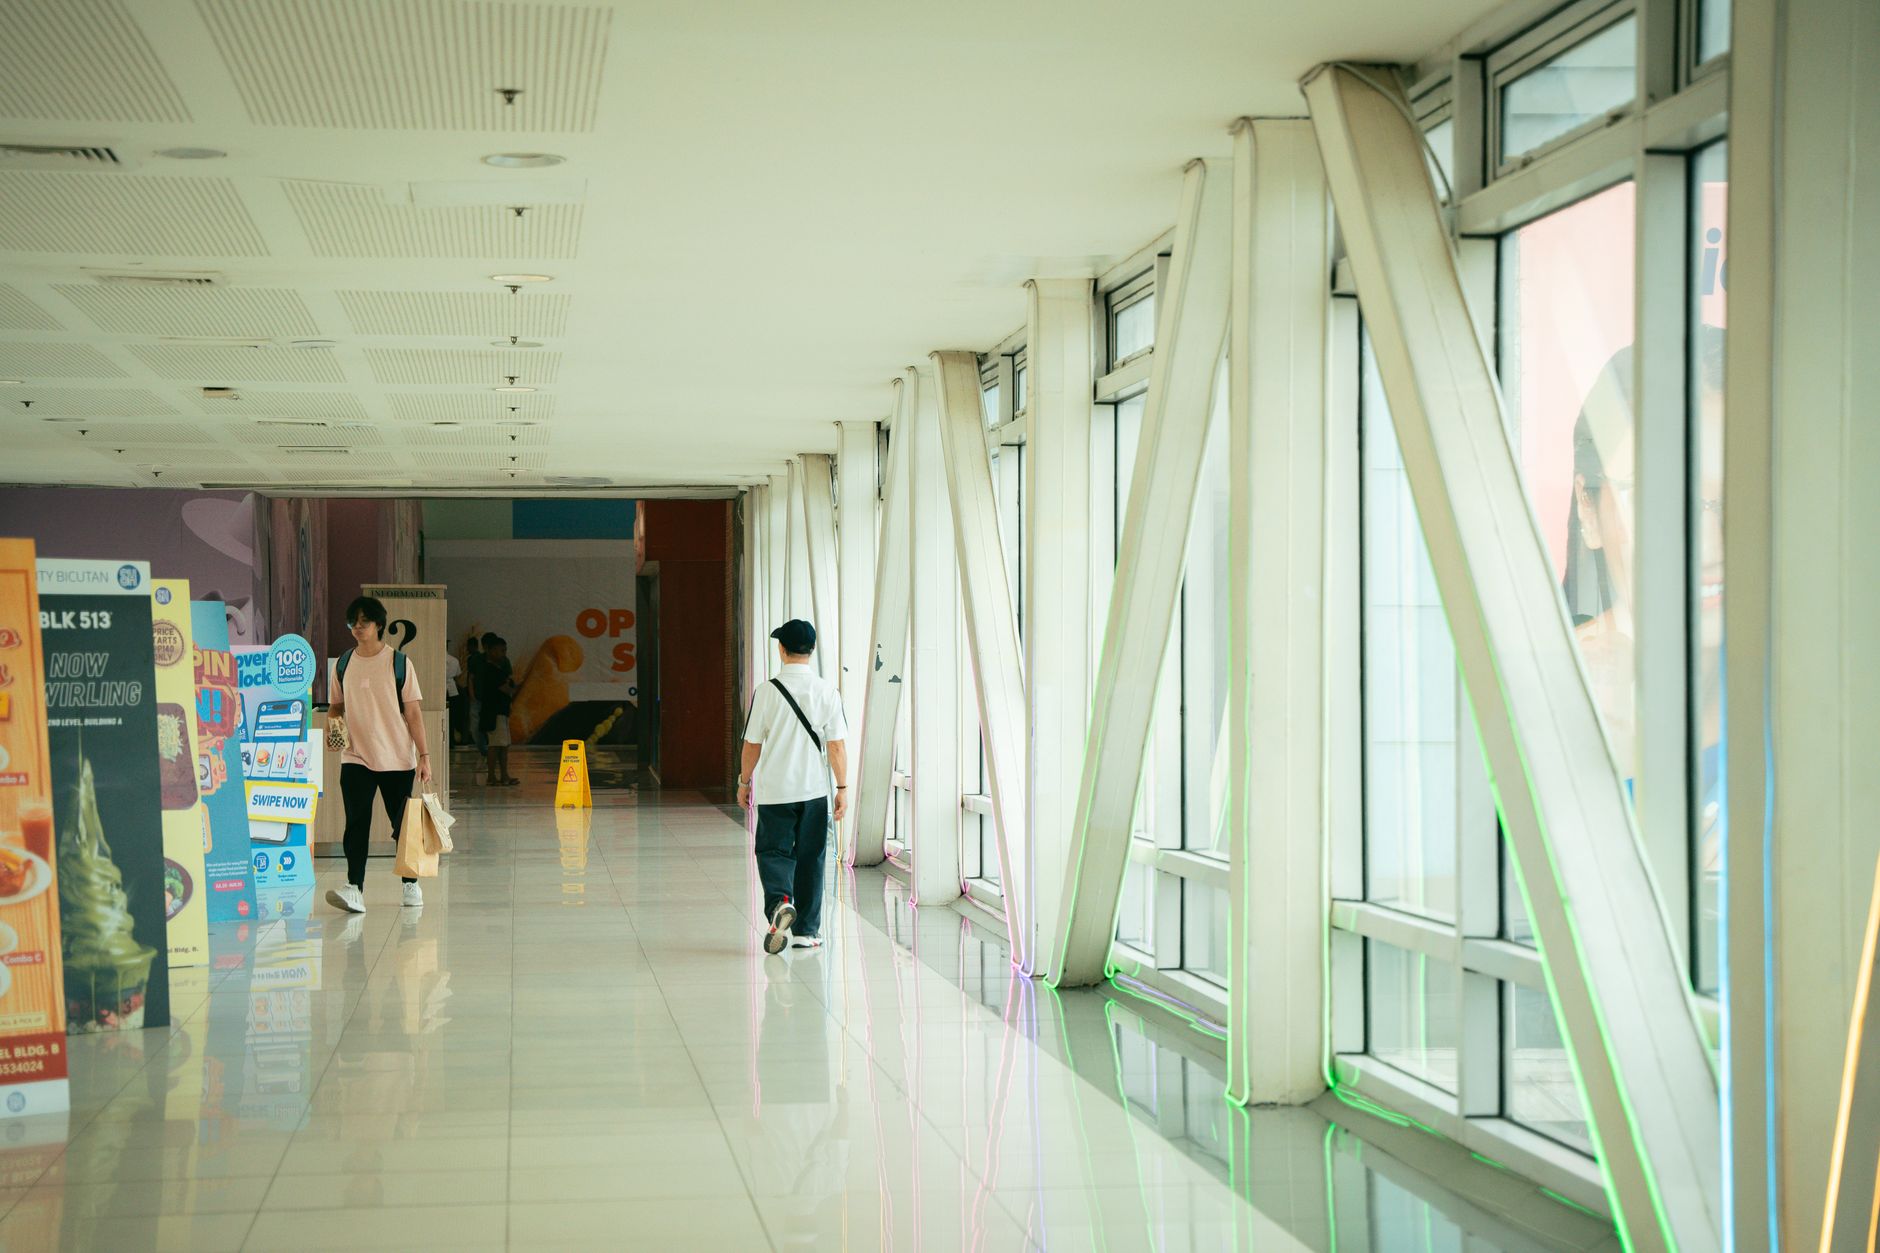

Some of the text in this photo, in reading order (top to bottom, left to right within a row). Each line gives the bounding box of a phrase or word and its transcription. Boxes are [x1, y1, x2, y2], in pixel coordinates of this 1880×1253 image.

[56, 570, 109, 583] BICUTAN
[371, 589, 438, 598] INFORMATION
[40, 611, 111, 630] BLK 513
[576, 608, 635, 638] OP
[50, 653, 109, 677] NOW
[611, 643, 635, 672] S
[238, 668, 271, 688] lock
[278, 665, 303, 677] Deals
[252, 794, 308, 809] SWIPE NOW
[14, 1045, 48, 1058] BLDG.
